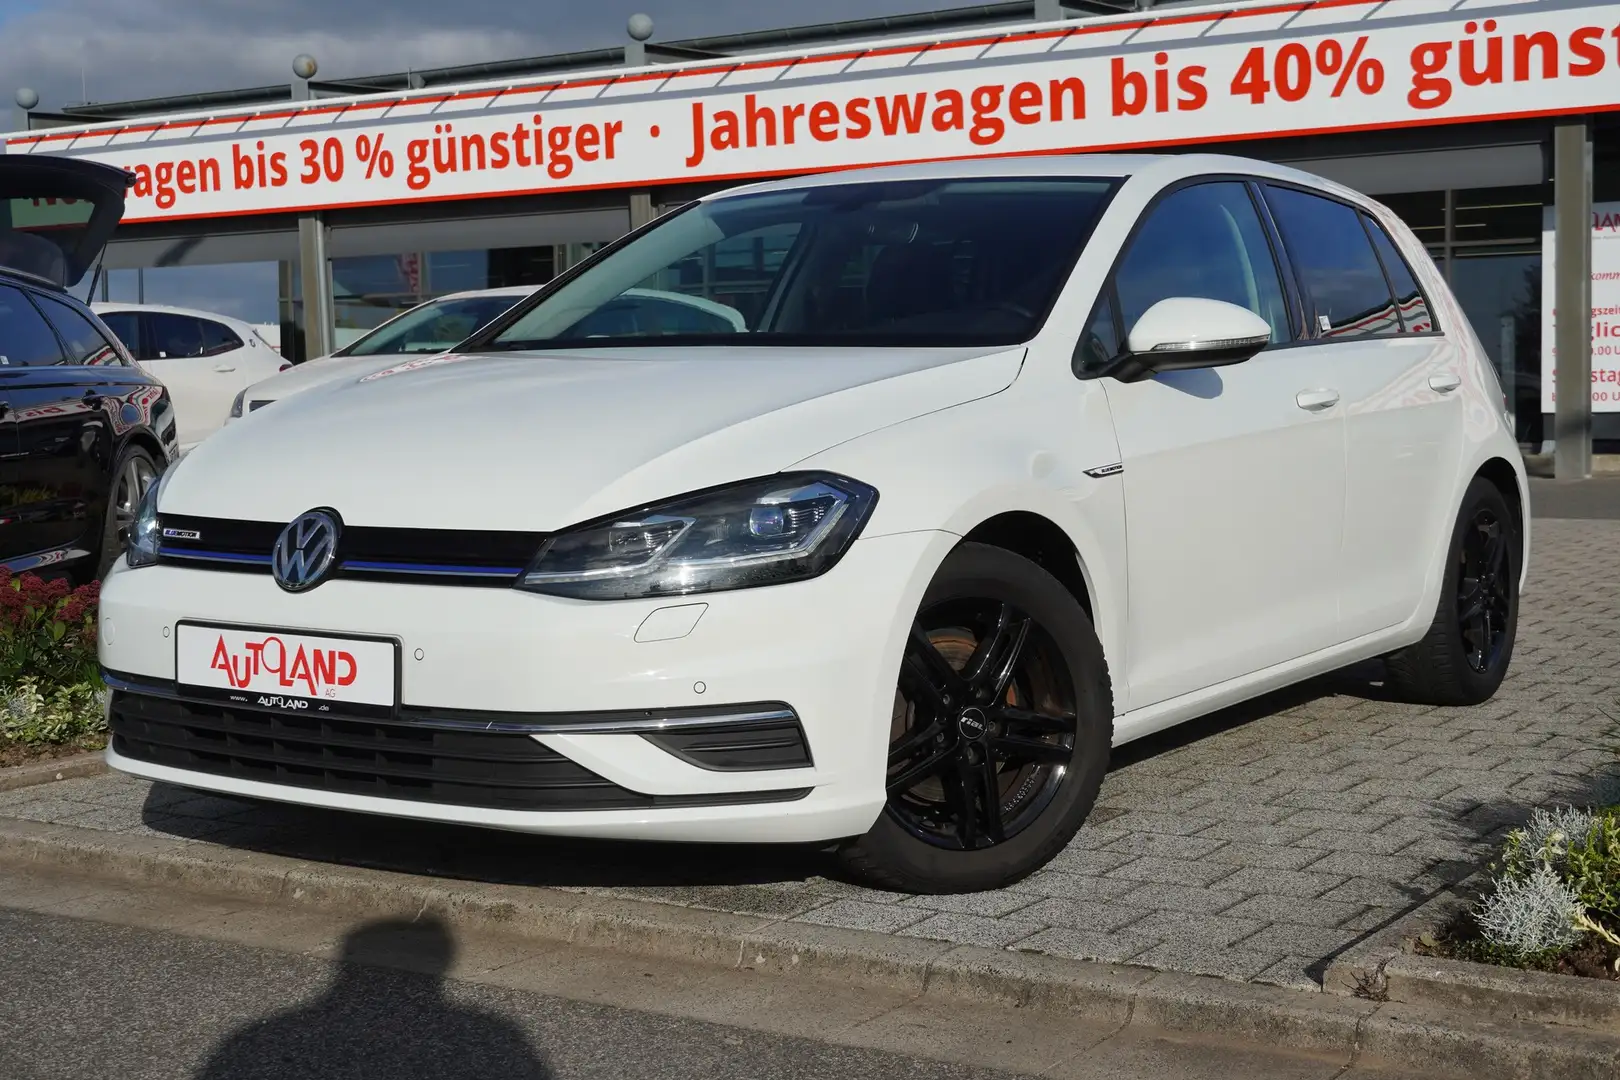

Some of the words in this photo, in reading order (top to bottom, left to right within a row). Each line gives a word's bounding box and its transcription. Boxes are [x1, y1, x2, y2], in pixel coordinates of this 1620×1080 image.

[124, 158, 220, 210] agen
[232, 144, 288, 190] bis
[300, 137, 345, 185] 30
[356, 132, 395, 180] %
[407, 114, 623, 189] günstiger
[686, 76, 1087, 168] Jahreswagen
[1111, 52, 1208, 117] bis
[1230, 36, 1385, 105] 40%
[1591, 304, 1620, 318] gszei
[211, 634, 357, 696] AUTOLAND
[325, 688, 336, 699] AG
[257, 696, 309, 711] AUTOLAND
